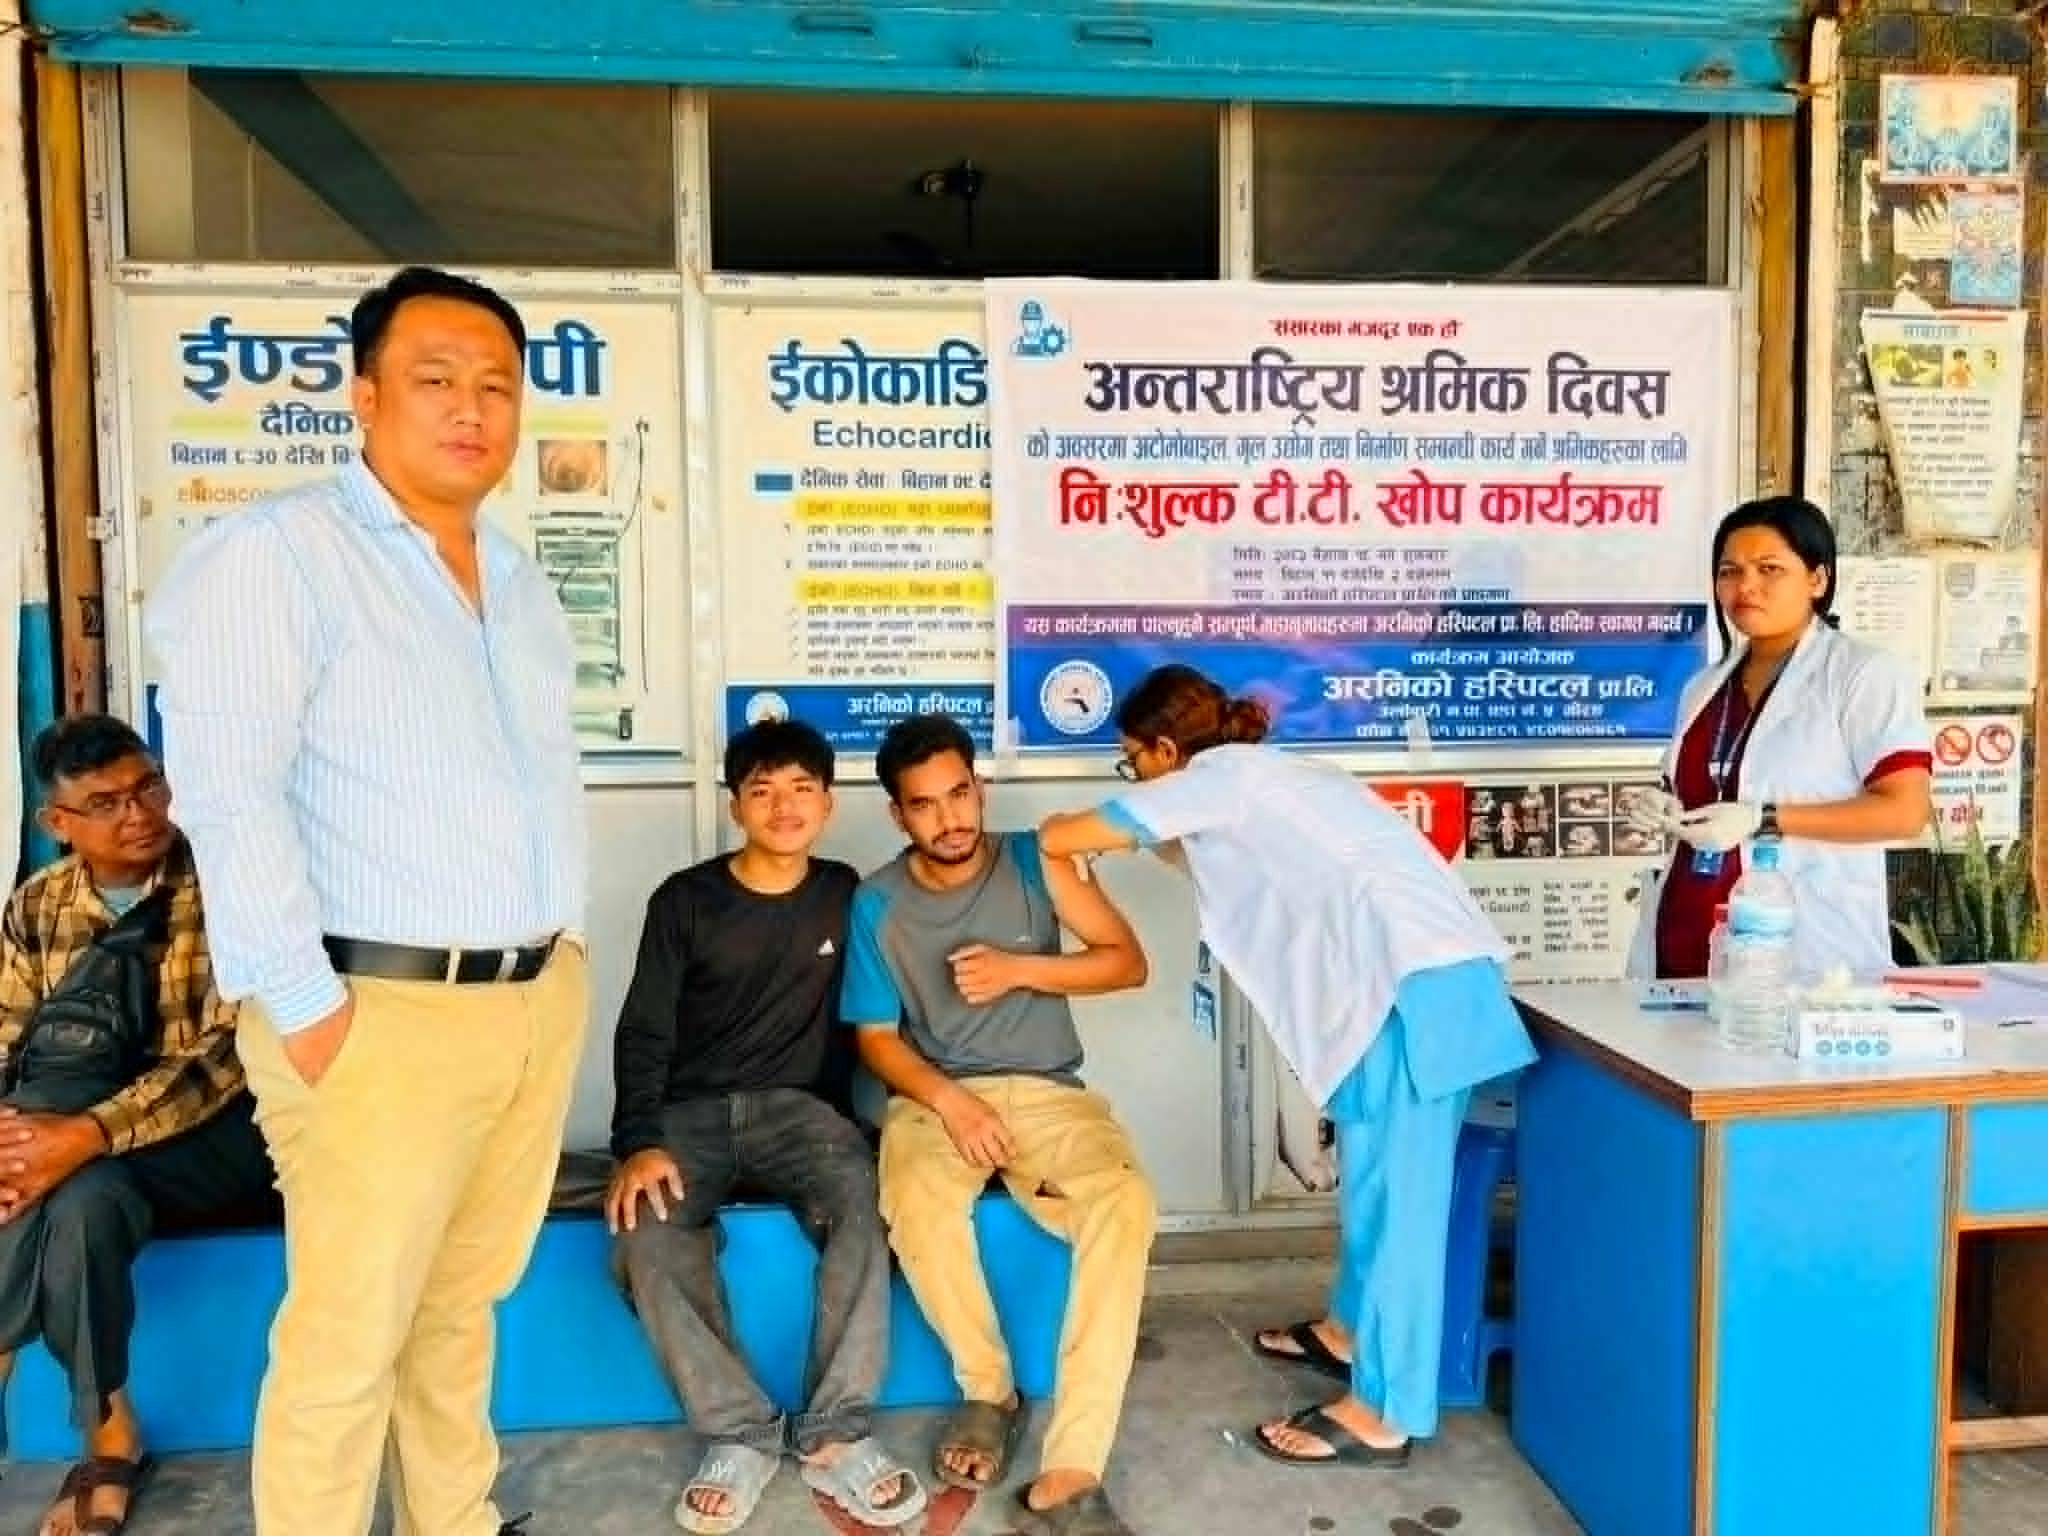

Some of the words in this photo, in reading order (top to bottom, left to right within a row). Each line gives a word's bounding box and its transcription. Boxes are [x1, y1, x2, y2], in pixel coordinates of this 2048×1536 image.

[1380, 348, 1531, 416] श्रमिक
[1546, 350, 1671, 420] दिवस
[257, 401, 354, 436] दैनिक
[1055, 434, 1128, 459] अवसरमा
[1253, 468, 1362, 525] टी.टी.
[1376, 469, 1467, 526] खोप
[1480, 472, 1664, 528] कार्यक्रम
[847, 692, 913, 713] अरनिको
[1324, 669, 1456, 703] अरनिको
